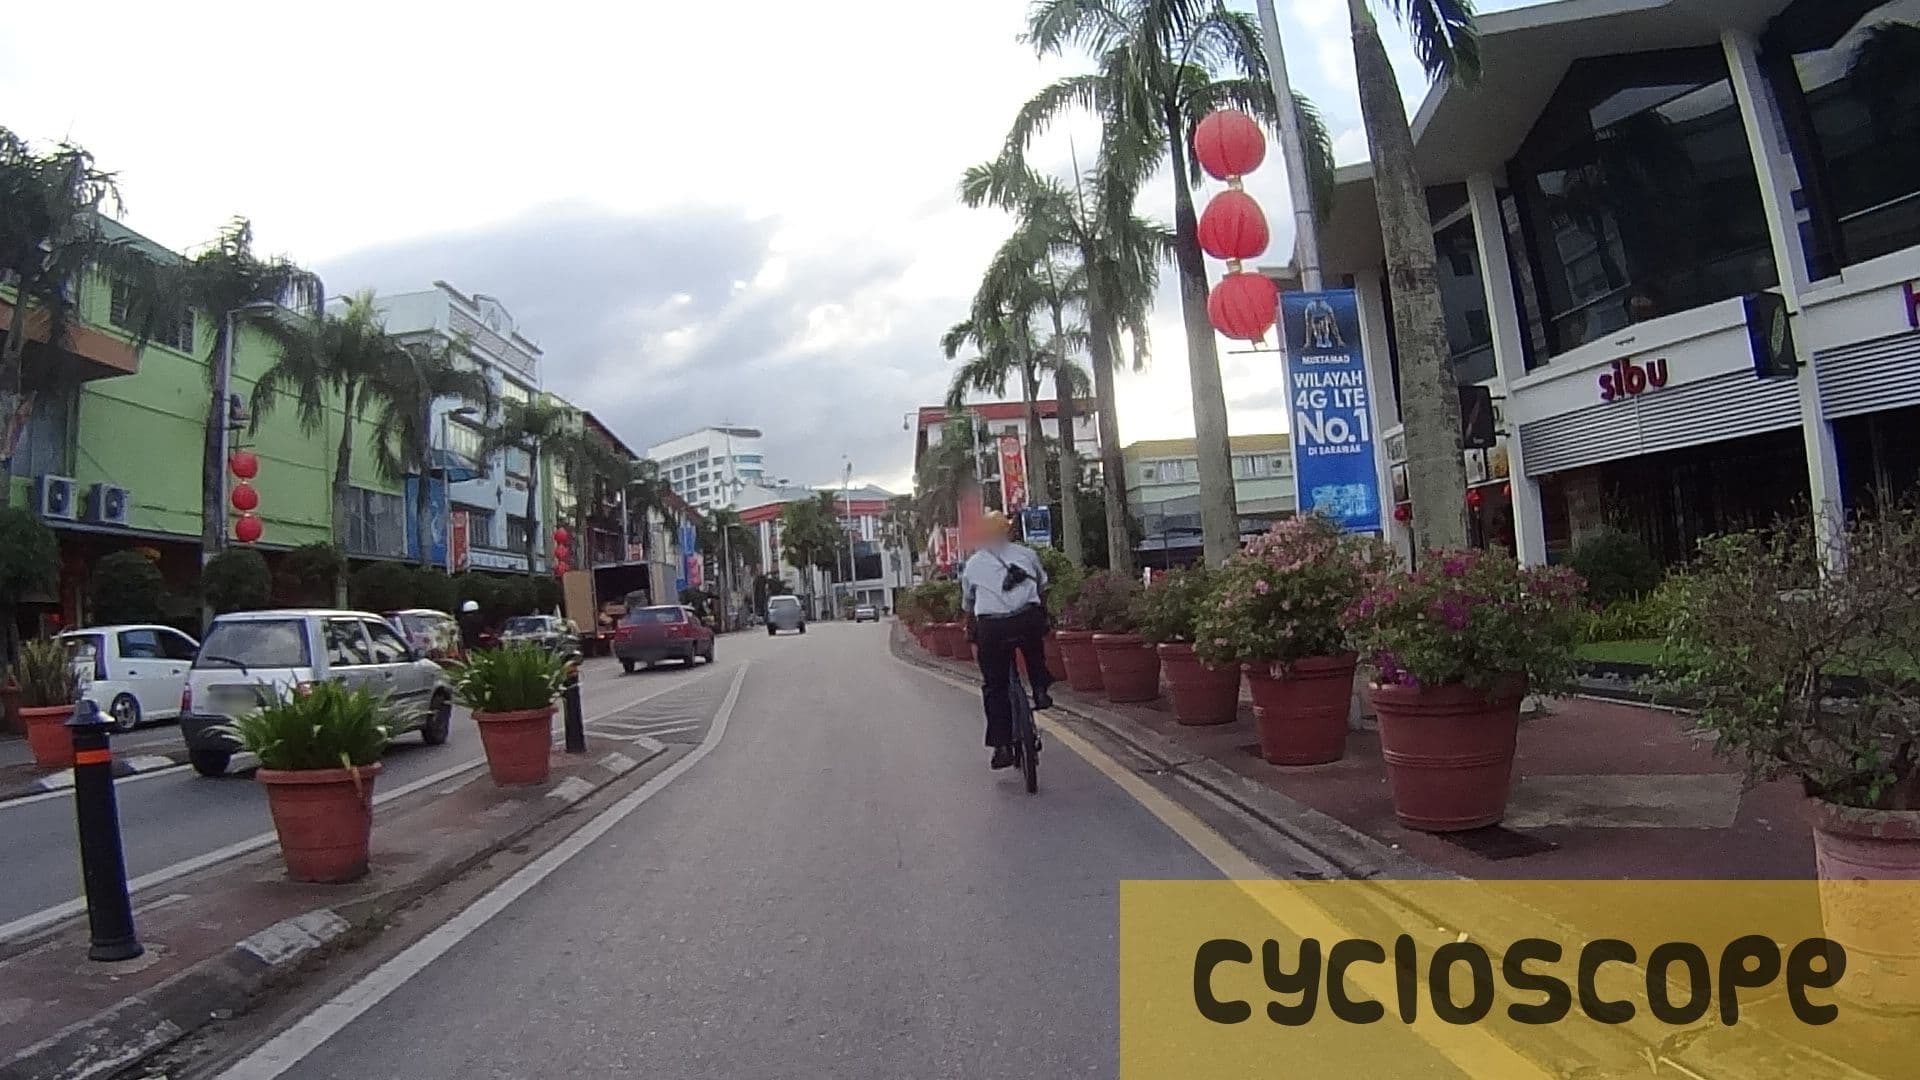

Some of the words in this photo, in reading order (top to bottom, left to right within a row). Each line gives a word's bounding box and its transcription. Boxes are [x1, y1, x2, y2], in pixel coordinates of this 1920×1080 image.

[1294, 370, 1363, 388] WILAYAH
[1598, 357, 1668, 402] sibu
[1296, 389, 1328, 409] 4G
[1334, 387, 1366, 408] LTE
[1297, 408, 1369, 446] No.1
[1308, 446, 1319, 456] DI
